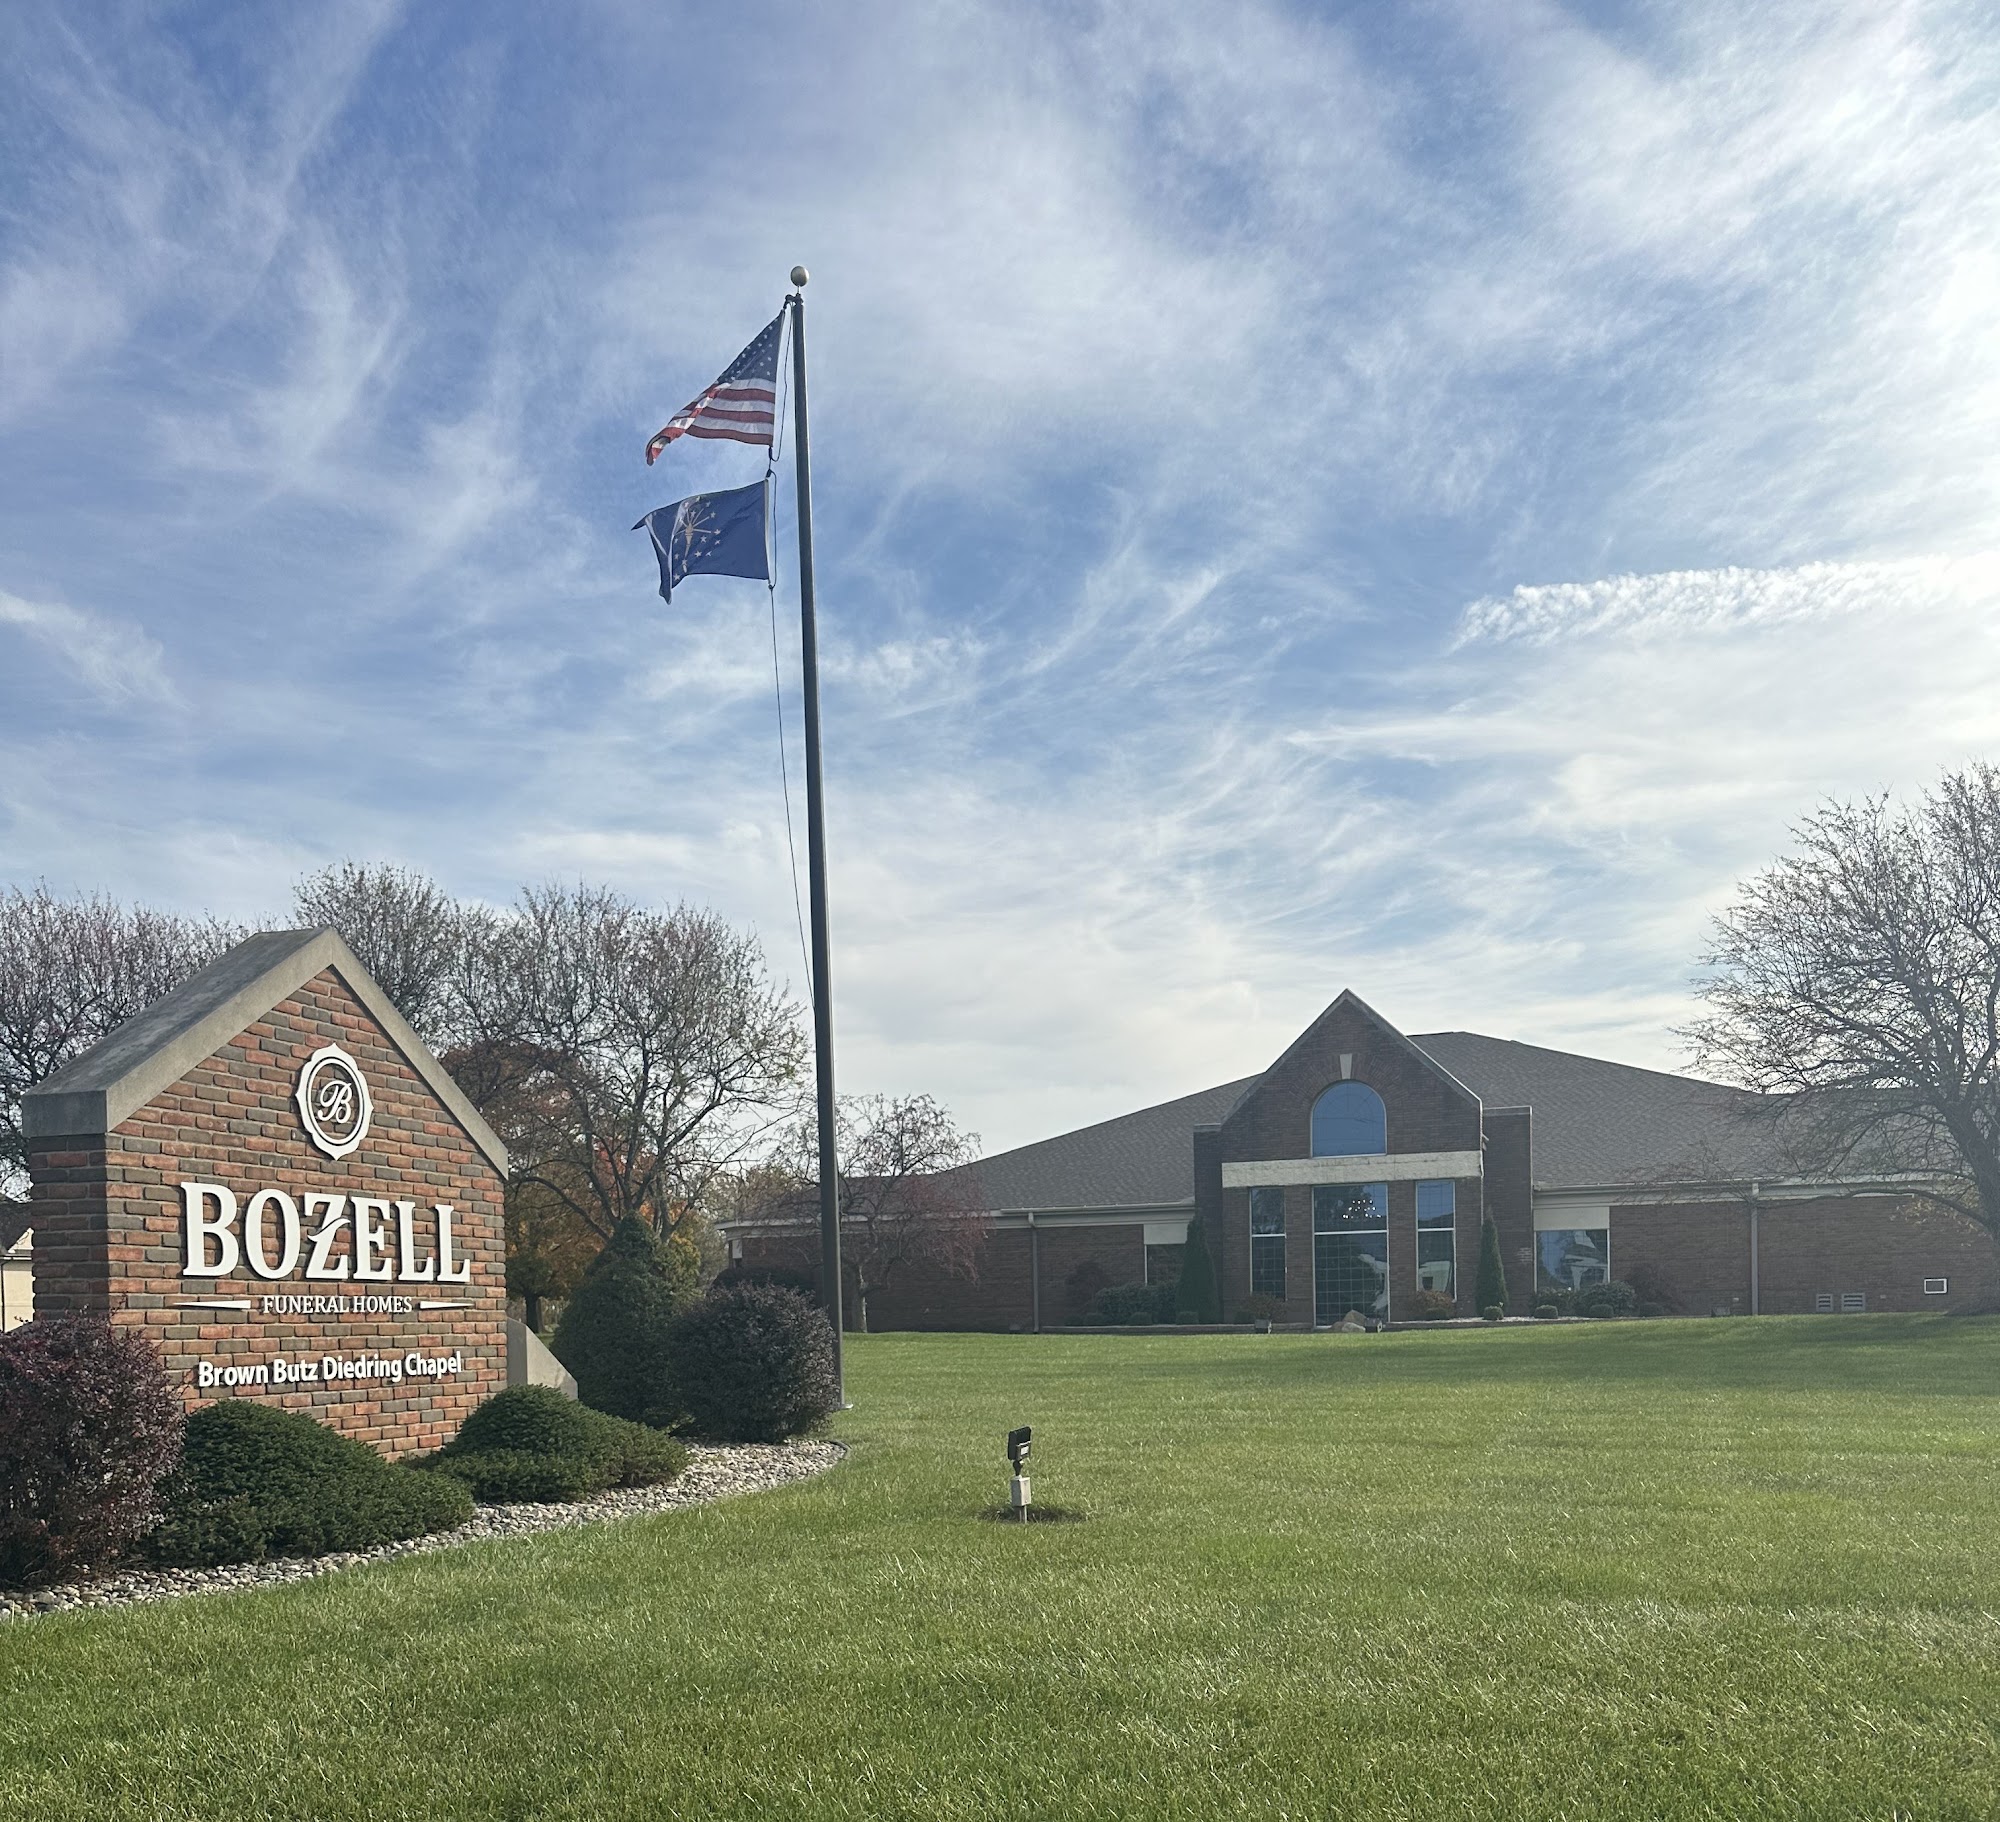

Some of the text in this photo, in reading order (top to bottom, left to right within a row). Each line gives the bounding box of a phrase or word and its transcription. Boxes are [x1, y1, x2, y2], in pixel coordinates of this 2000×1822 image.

[180, 1181, 471, 1283] BOZELL
[262, 1296, 412, 1314] FUNERAL HOMES
[199, 1351, 462, 1387] Brown Butz Diedring Chapel
